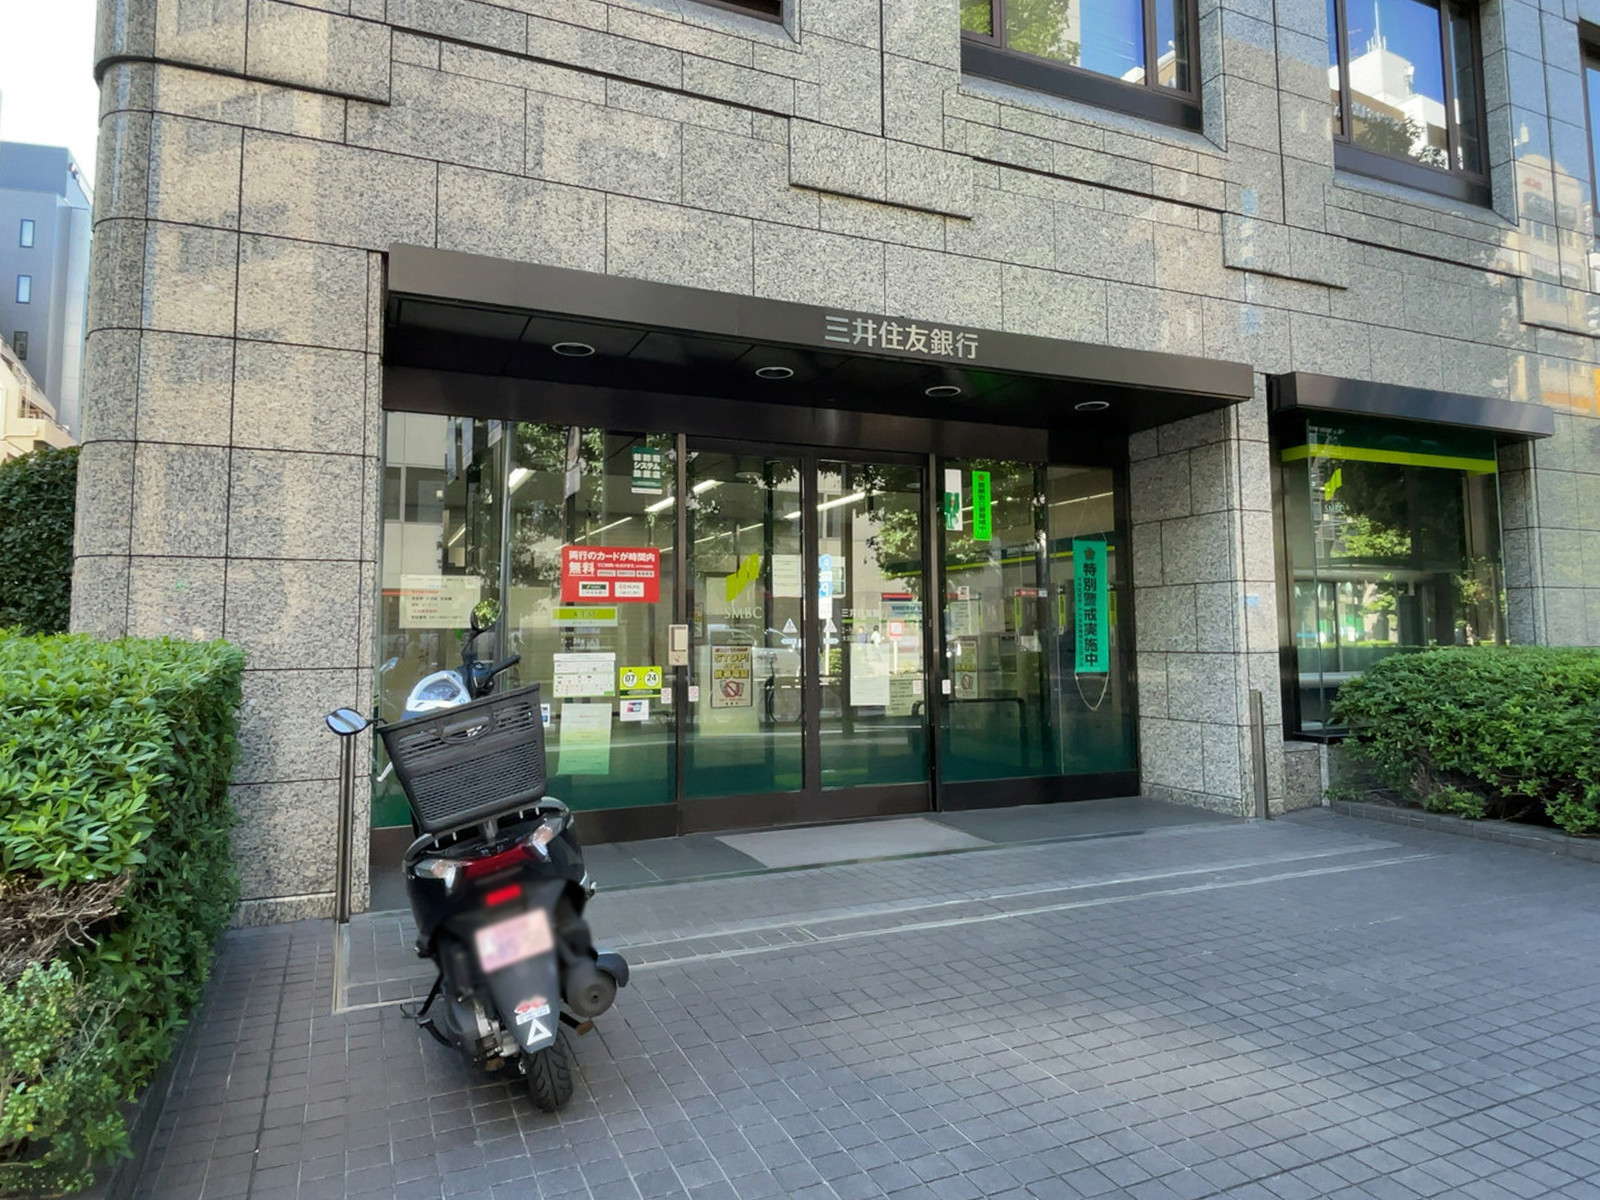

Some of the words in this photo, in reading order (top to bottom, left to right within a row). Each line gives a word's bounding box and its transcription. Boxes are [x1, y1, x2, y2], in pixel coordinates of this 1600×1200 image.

[825, 315, 979, 360] 三井住友銀行
[633, 461, 661, 471] システム
[568, 550, 656, 562] 両行のカードが時間内
[569, 561, 595, 574] 無料
[724, 606, 762, 619] SMBC
[1083, 562, 1099, 667] 特別警戒実施中
[713, 653, 749, 663] STOP!
[624, 674, 636, 683] 07
[646, 673, 658, 682] 24
